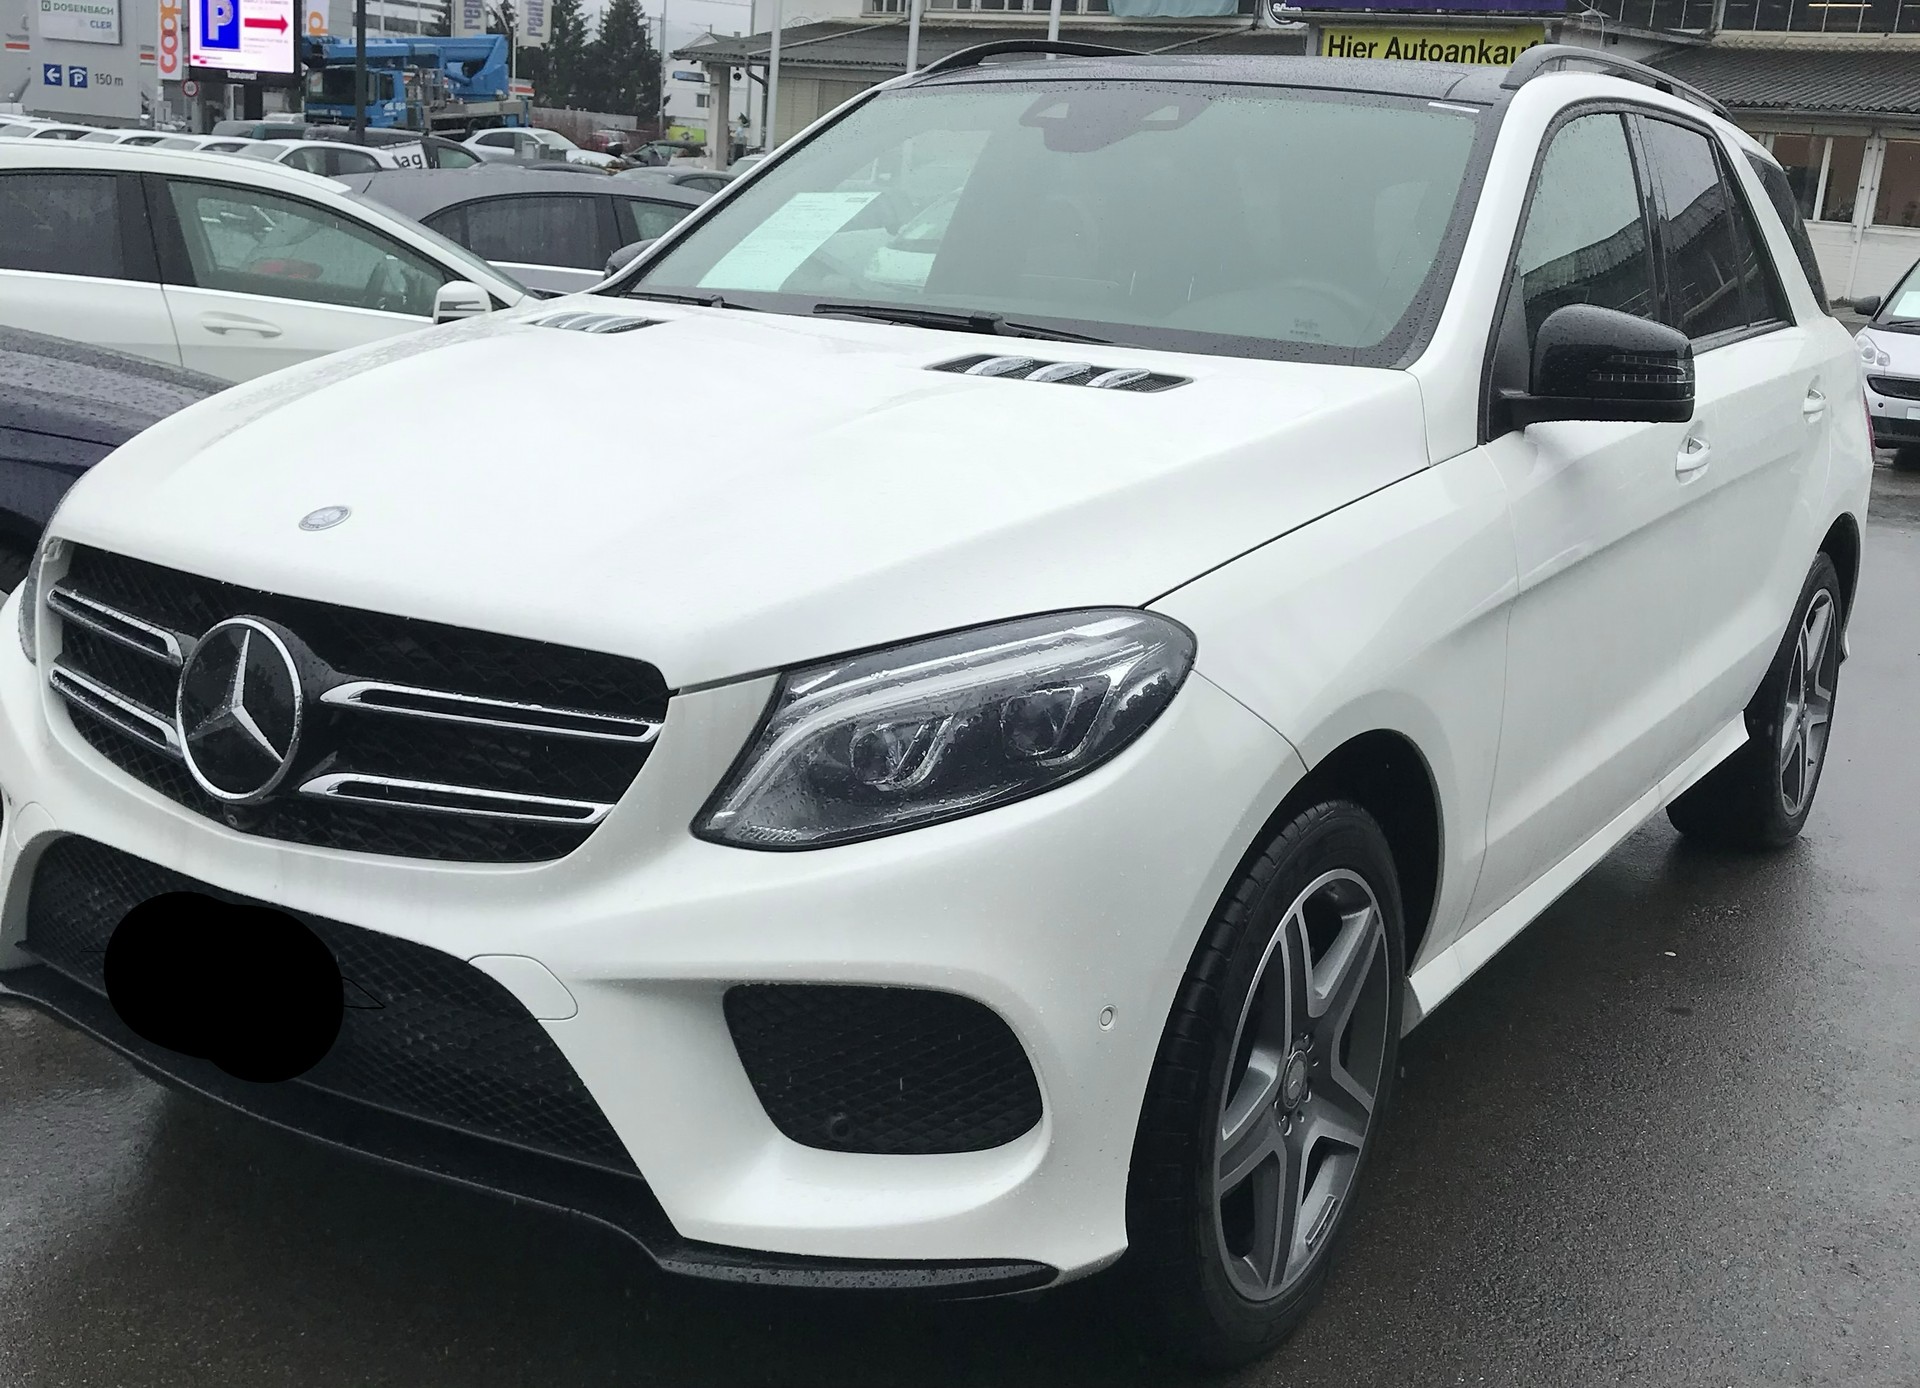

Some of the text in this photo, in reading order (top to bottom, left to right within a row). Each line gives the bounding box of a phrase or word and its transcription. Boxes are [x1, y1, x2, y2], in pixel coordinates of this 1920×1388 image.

[53, 2, 114, 15] DOSENBACH
[90, 20, 112, 29] CLER
[1328, 34, 1539, 65] Hier Autoankau
[95, 73, 112, 85] 150
[115, 77, 123, 86] m
